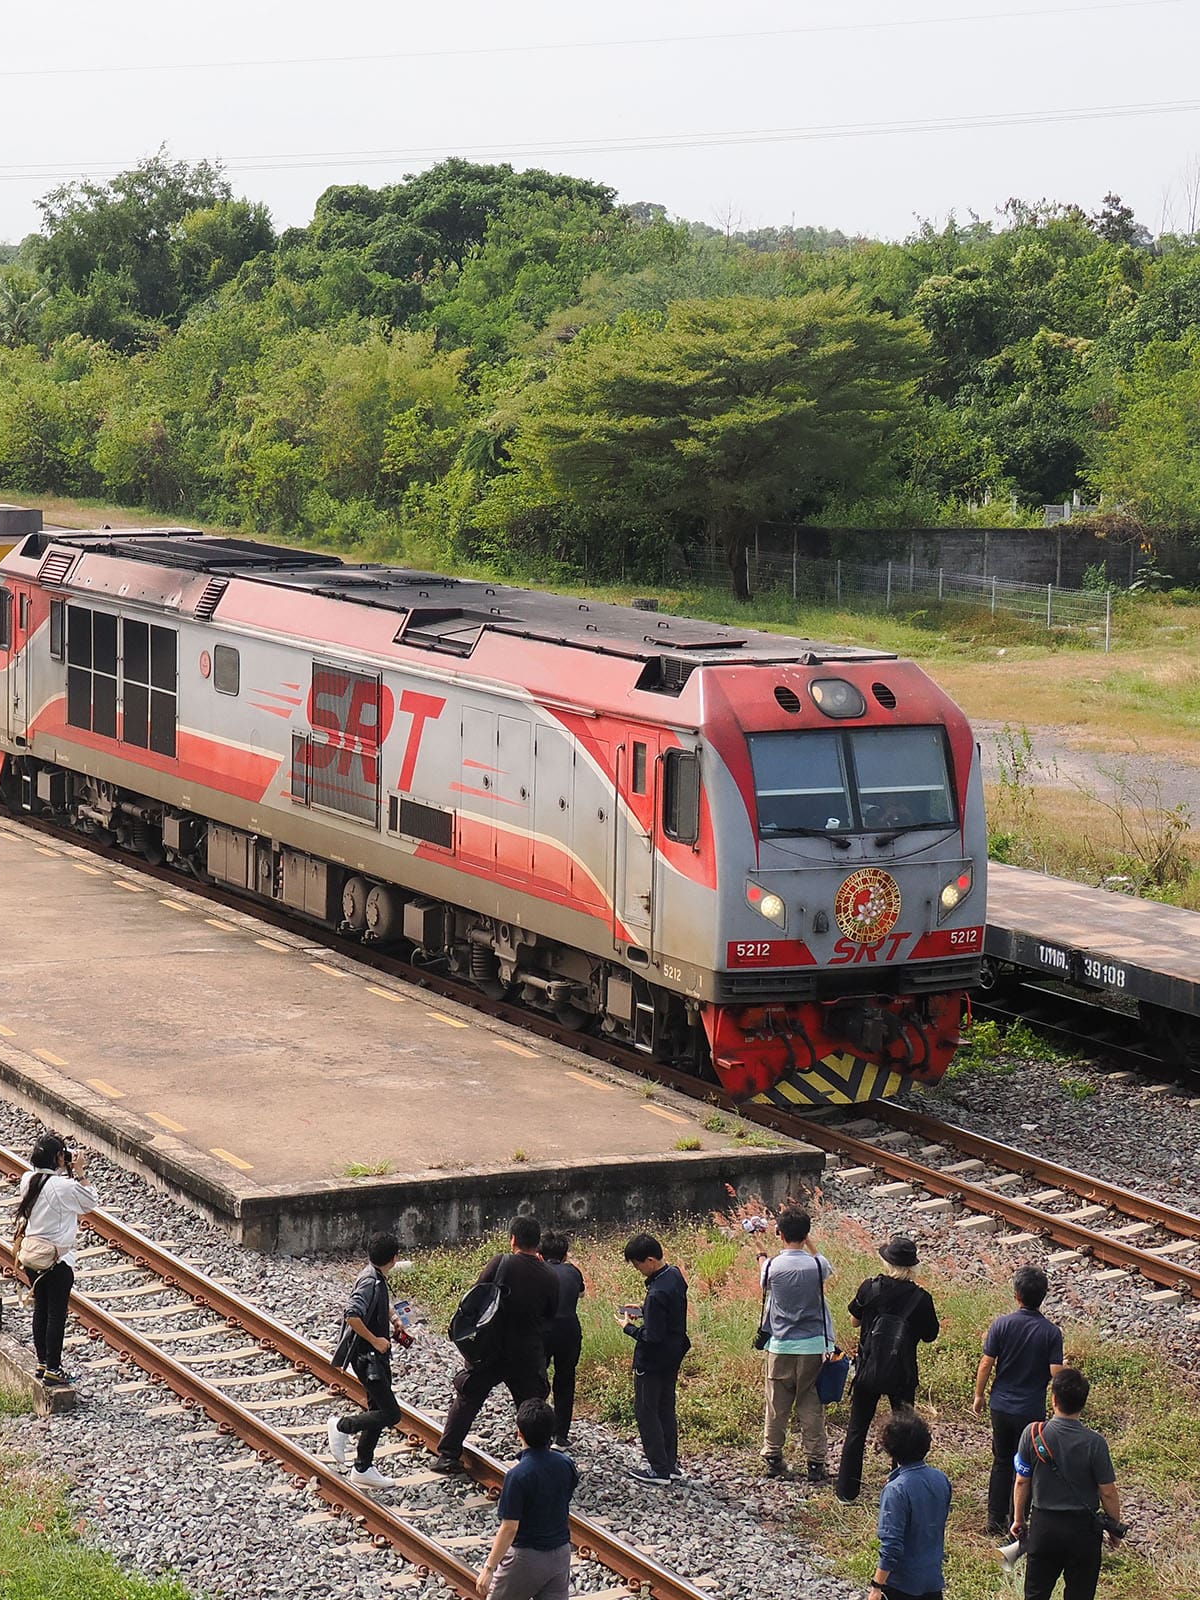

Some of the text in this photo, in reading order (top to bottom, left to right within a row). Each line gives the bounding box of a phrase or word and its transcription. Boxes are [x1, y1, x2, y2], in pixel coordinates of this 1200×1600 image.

[294, 671, 447, 793] SRT
[827, 931, 913, 965] SRT
[950, 930, 978, 945] 5212
[736, 943, 771, 957] 5212
[663, 963, 682, 982] 5212
[1084, 958, 1126, 988] 39108
